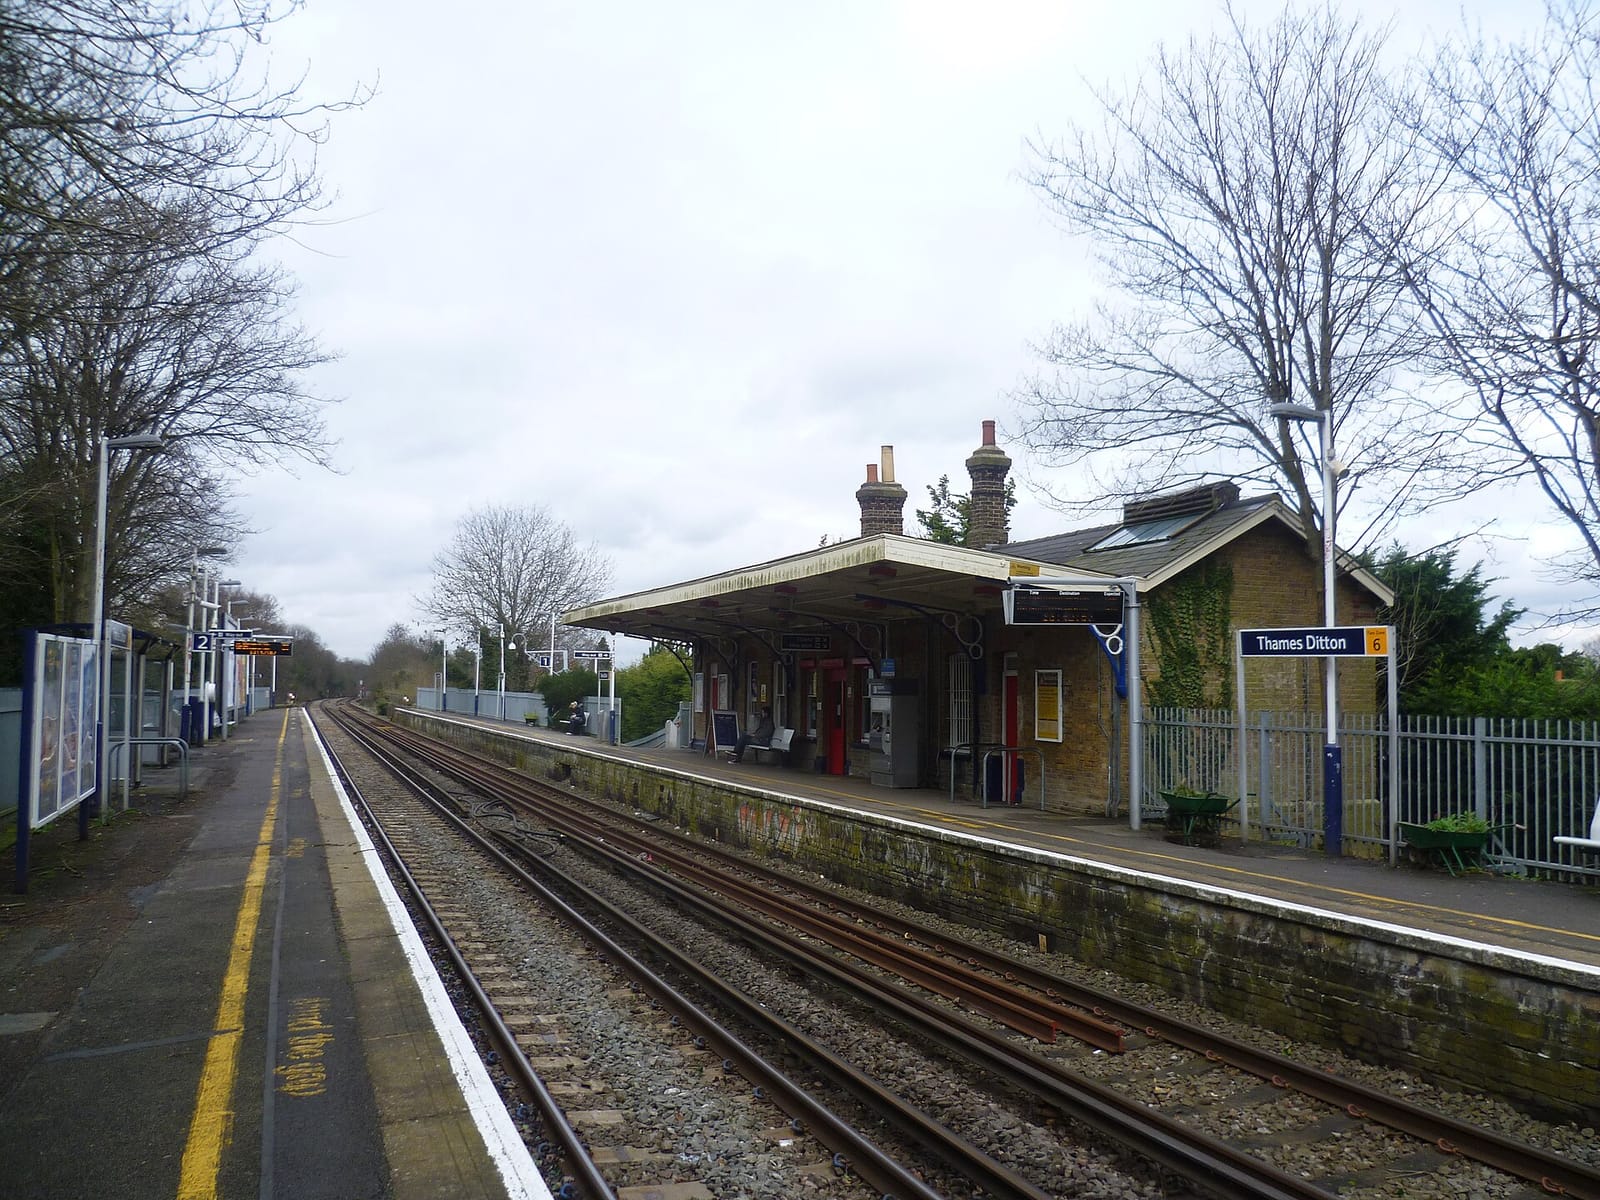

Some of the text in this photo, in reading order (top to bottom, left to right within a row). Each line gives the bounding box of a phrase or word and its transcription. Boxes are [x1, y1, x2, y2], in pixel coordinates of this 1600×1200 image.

[197, 636, 209, 649] 2
[1256, 635, 1347, 651] Thames Ditton
[1373, 638, 1381, 651] 6
[543, 657, 548, 666] 1
[287, 1033, 336, 1060] the
[273, 1062, 327, 1097] gap
